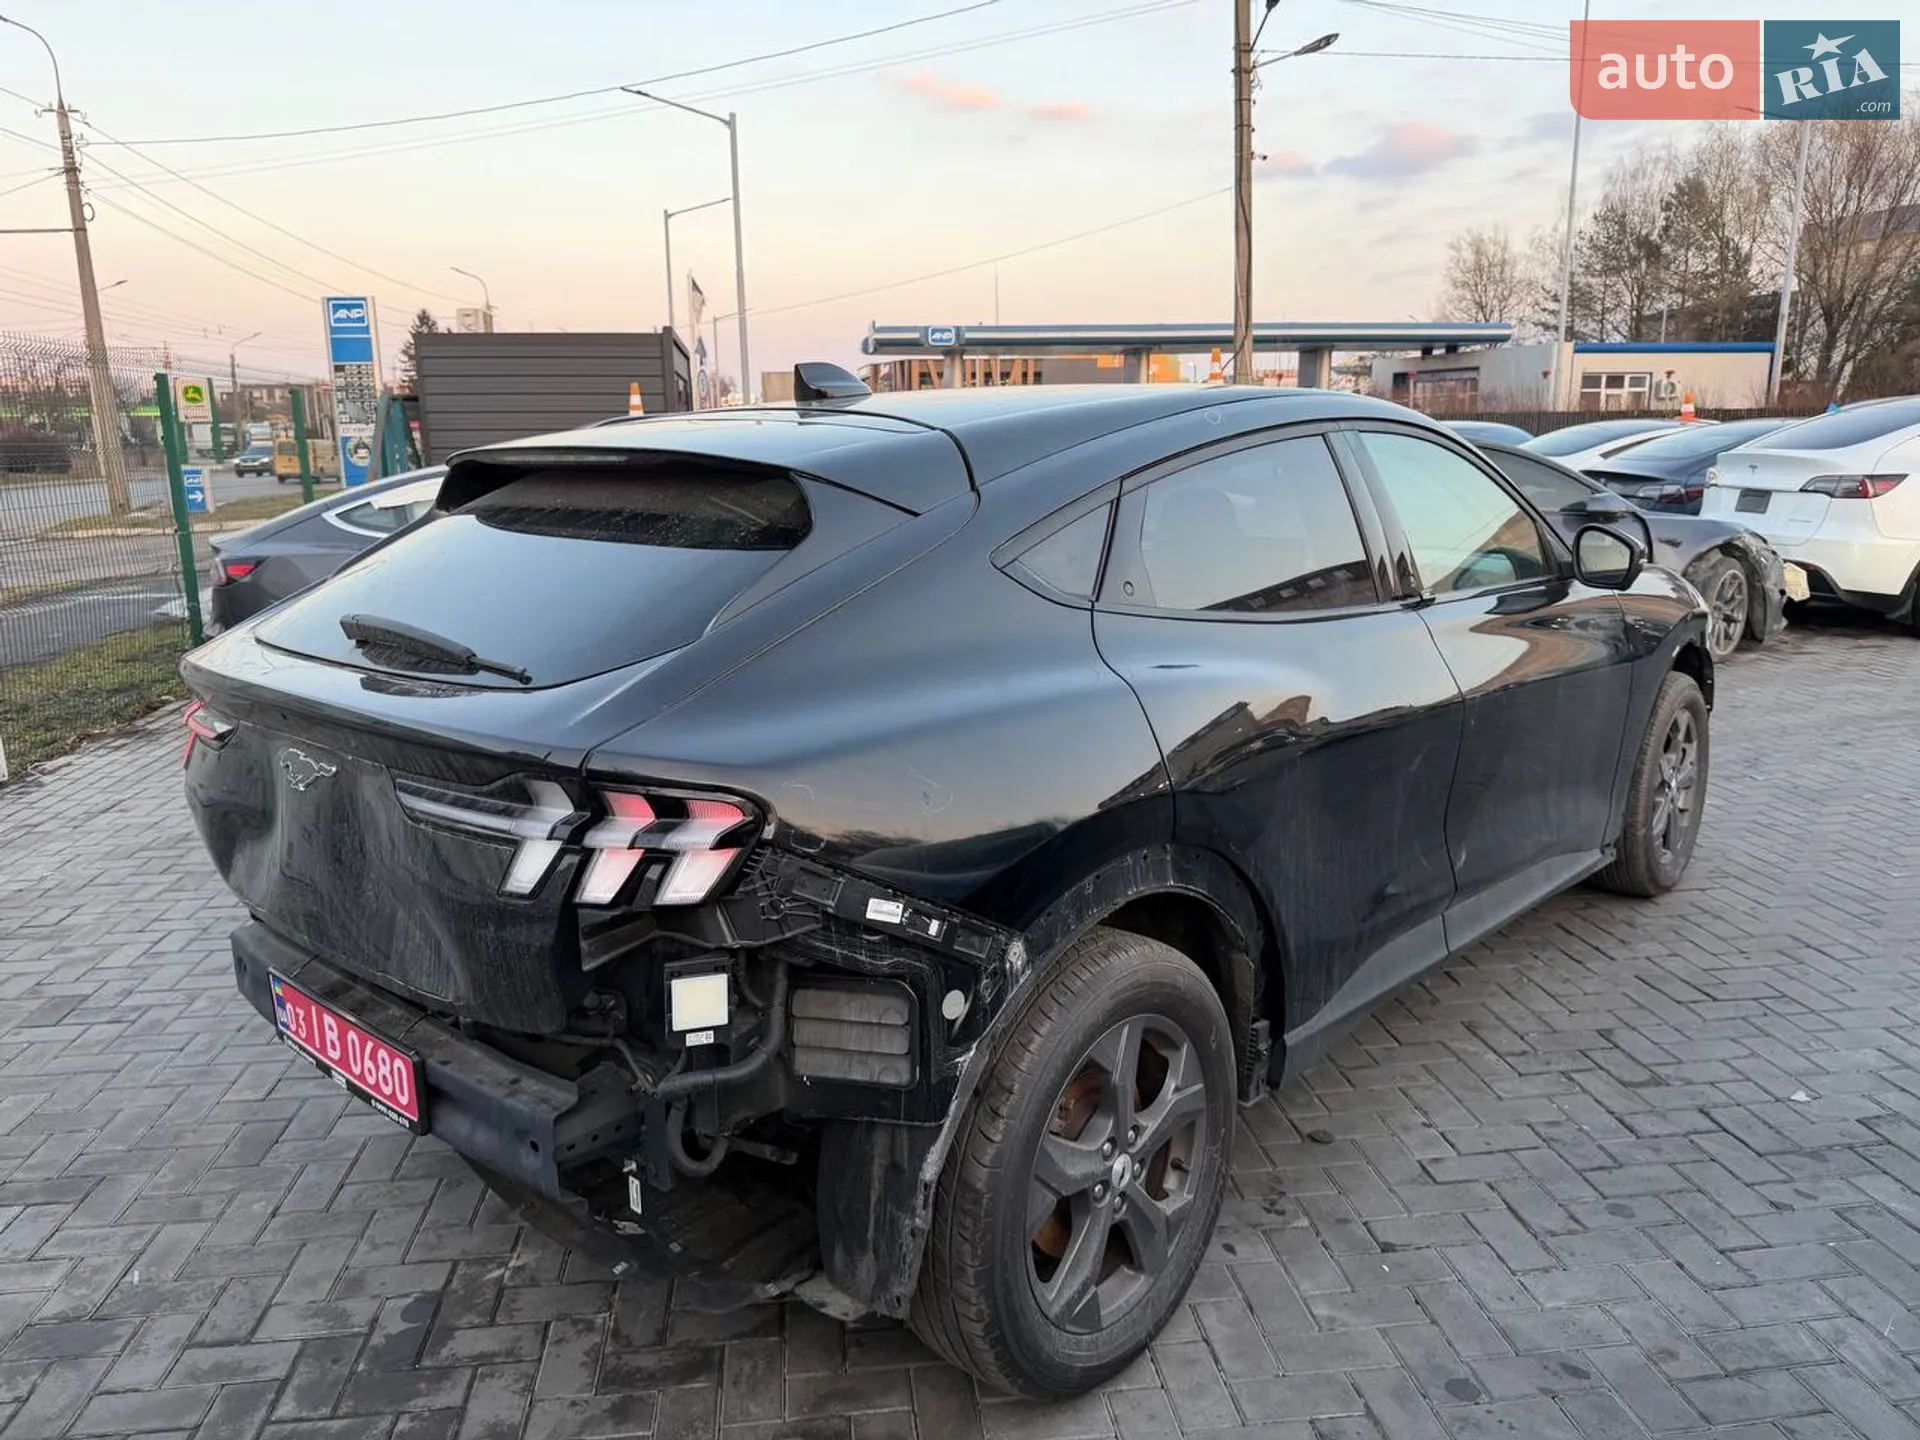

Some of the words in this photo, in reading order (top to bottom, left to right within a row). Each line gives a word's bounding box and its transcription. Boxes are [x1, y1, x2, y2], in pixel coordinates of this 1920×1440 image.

[286, 1002, 306, 1039] 03
[311, 1005, 341, 1061] IB
[347, 1030, 409, 1106] 0680
